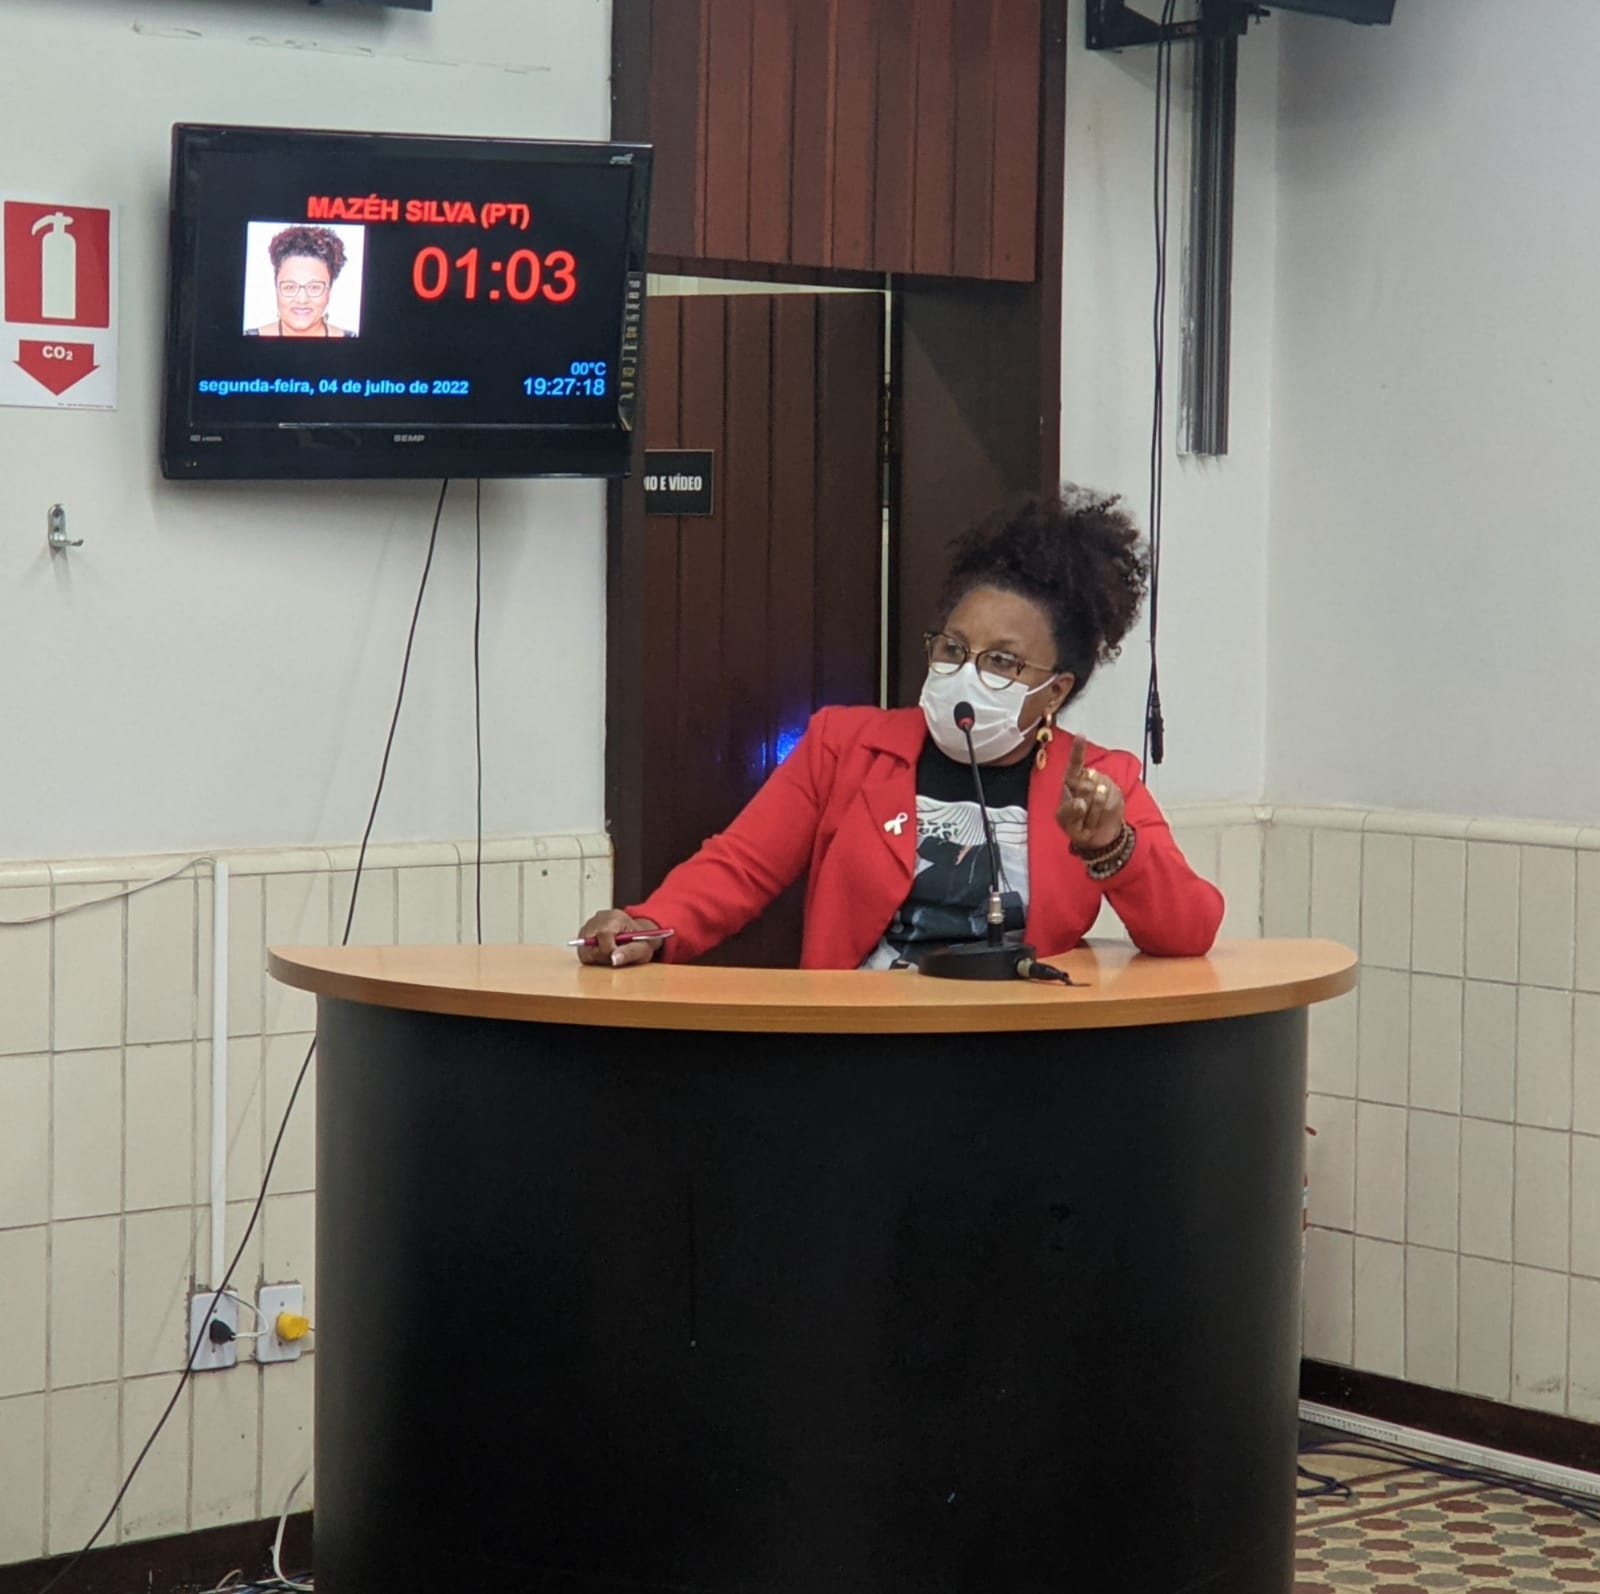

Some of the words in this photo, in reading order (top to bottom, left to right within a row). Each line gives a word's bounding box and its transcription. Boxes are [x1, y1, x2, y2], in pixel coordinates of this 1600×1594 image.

[307, 194, 399, 221] MAZÉH
[405, 200, 477, 224] SILVA
[480, 202, 531, 231] (PT)
[412, 246, 577, 302] 01:03
[198, 379, 315, 395] segunda-feira,
[319, 380, 338, 394] 04
[341, 380, 361, 393] de
[364, 380, 406, 397] julho
[409, 381, 429, 394] de
[432, 381, 469, 395] 2022
[523, 377, 605, 396] 19:27:18
[660, 475, 667, 491] E
[668, 472, 702, 491] VÍDEO
